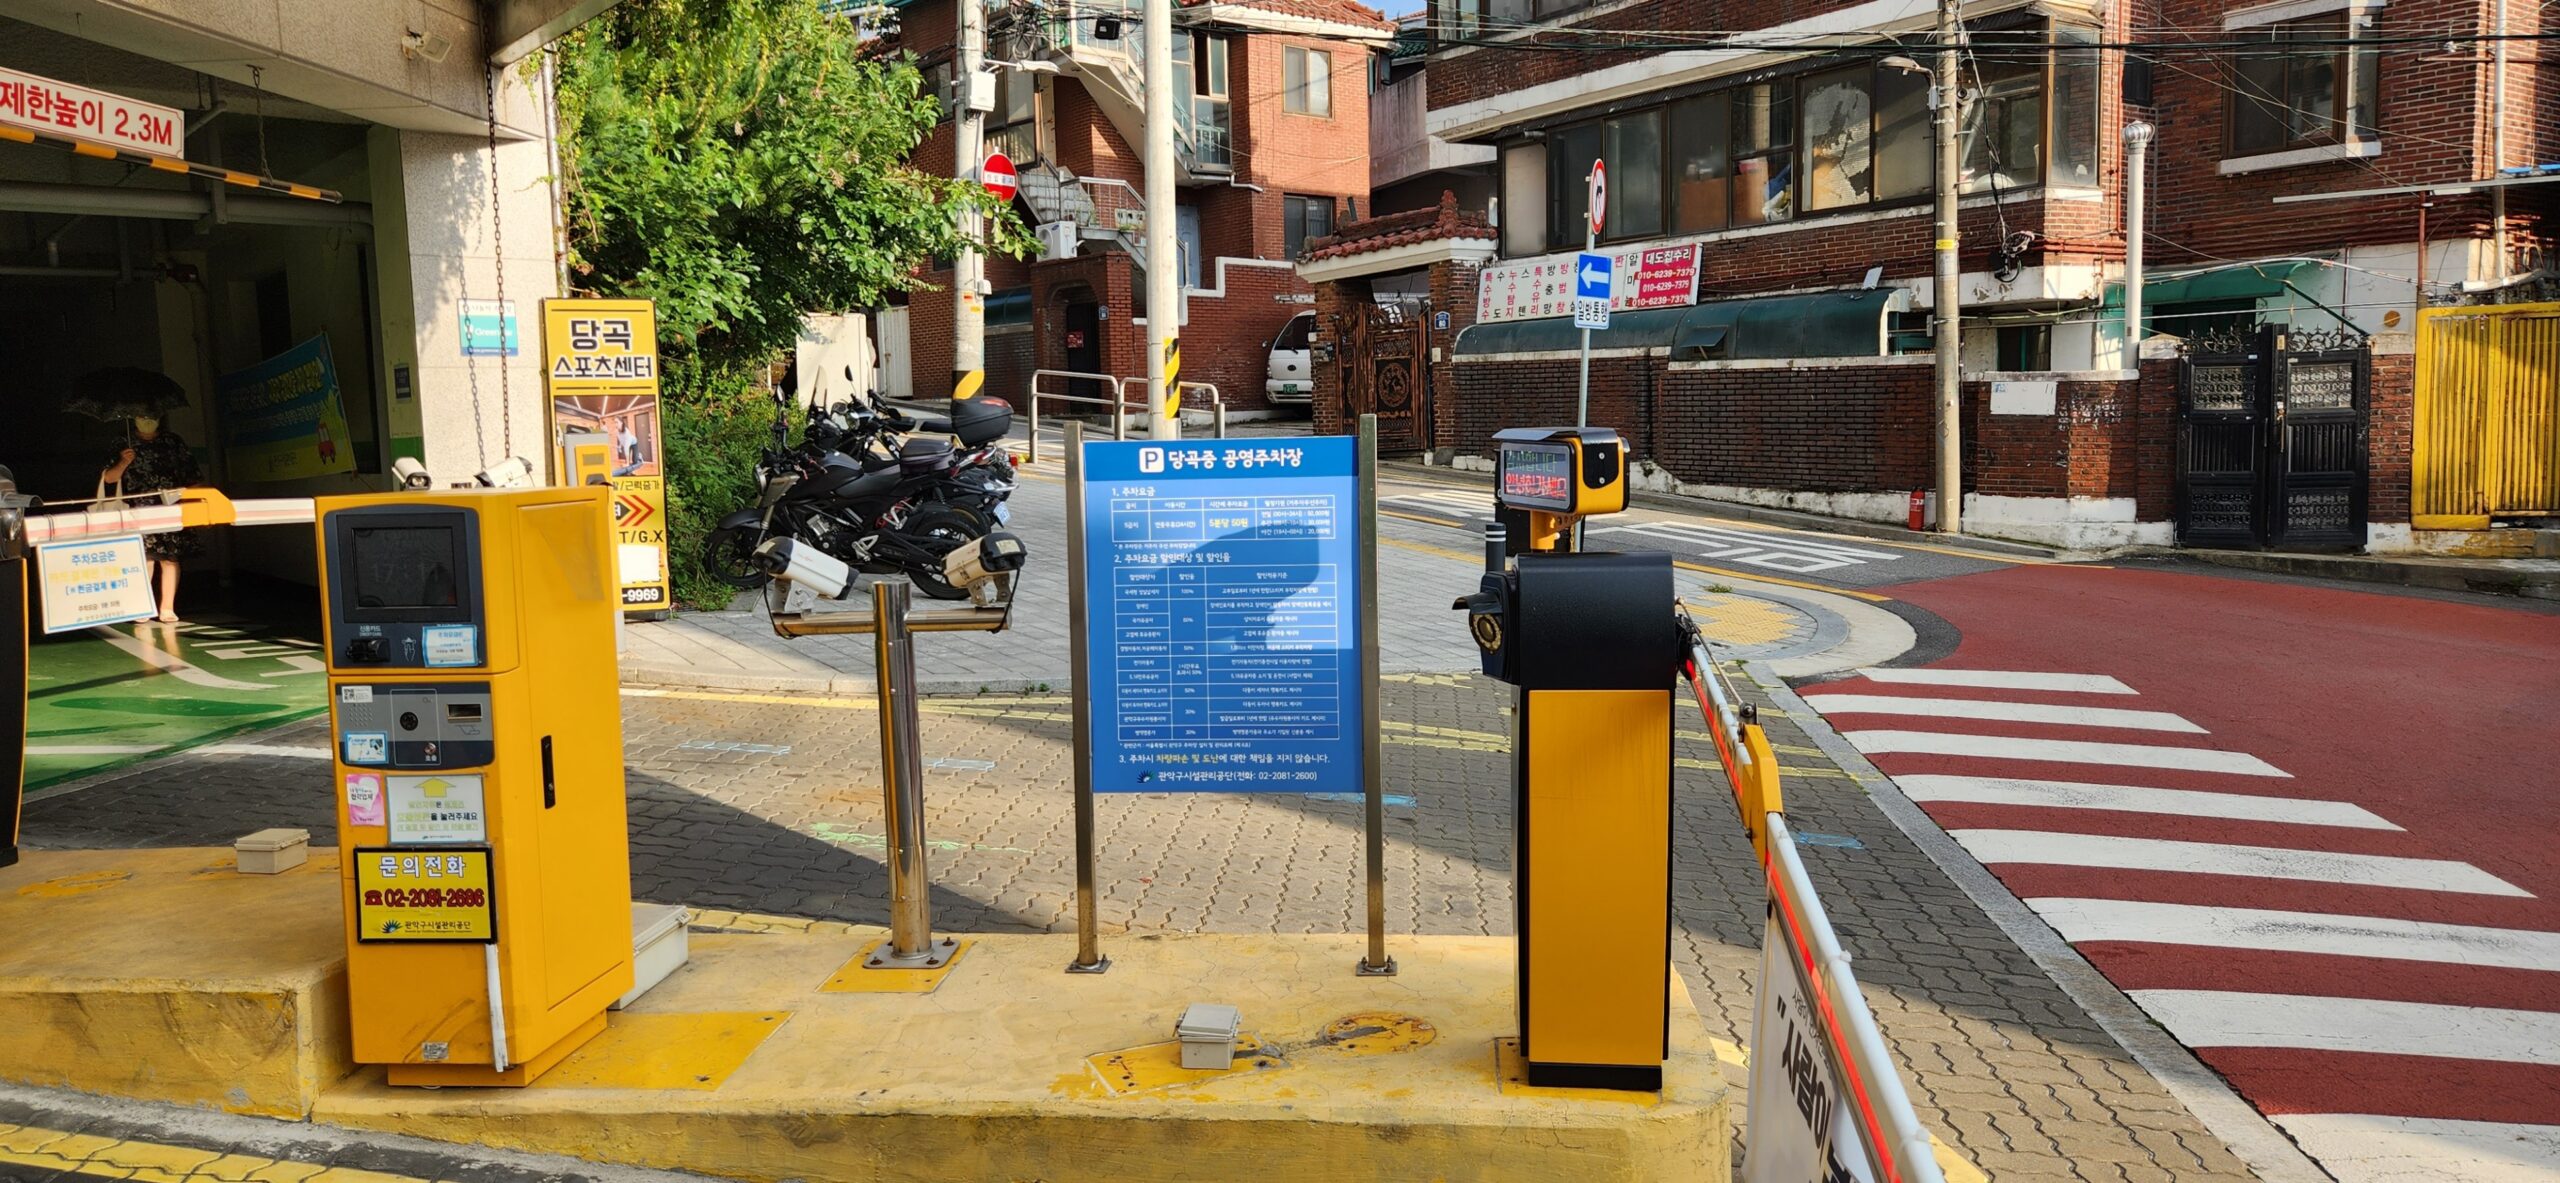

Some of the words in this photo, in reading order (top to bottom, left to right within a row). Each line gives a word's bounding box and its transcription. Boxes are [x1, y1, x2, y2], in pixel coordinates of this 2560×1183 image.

[0, 81, 103, 134] 제한높이
[115, 108, 172, 146] 2.3M
[1646, 248, 1691, 265] 대도집수리
[1637, 267, 1695, 280] 010-6239-7379
[1482, 272, 1493, 321] 특수방수
[1493, 271, 1505, 319] 수도
[1506, 271, 1516, 318] 누수탐지
[1531, 267, 1542, 316] 특수유리
[1543, 265, 1556, 315] 방충망
[1556, 263, 1569, 314] 방범창
[1632, 295, 1690, 307] 010-6239-7379
[1578, 301, 1607, 322] 일방통행
[571, 319, 631, 350] 당곡
[554, 356, 652, 378] 스포츠센터
[1222, 448, 1303, 468] 공영주차장
[1122, 487, 1155, 497] 주차요금
[72, 551, 116, 565] 주차요금은
[1124, 554, 1158, 563] 주차요금
[1160, 551, 1193, 564] 할인대상
[1196, 553, 1204, 562] 및
[1206, 552, 1230, 562] 할인율
[1129, 754, 1153, 764] 주차시
[1192, 754, 1199, 763] 및
[1202, 754, 1227, 763] 도난에
[1230, 754, 1246, 763] 대한
[1250, 754, 1274, 763] 책임을
[1295, 754, 1330, 763] 않습니다.
[440, 811, 477, 820] 눌러주세요
[379, 856, 466, 878] 문의전화
[384, 888, 485, 908] 02-2081-2686
[405, 921, 471, 930] 관악구시설관리공단
